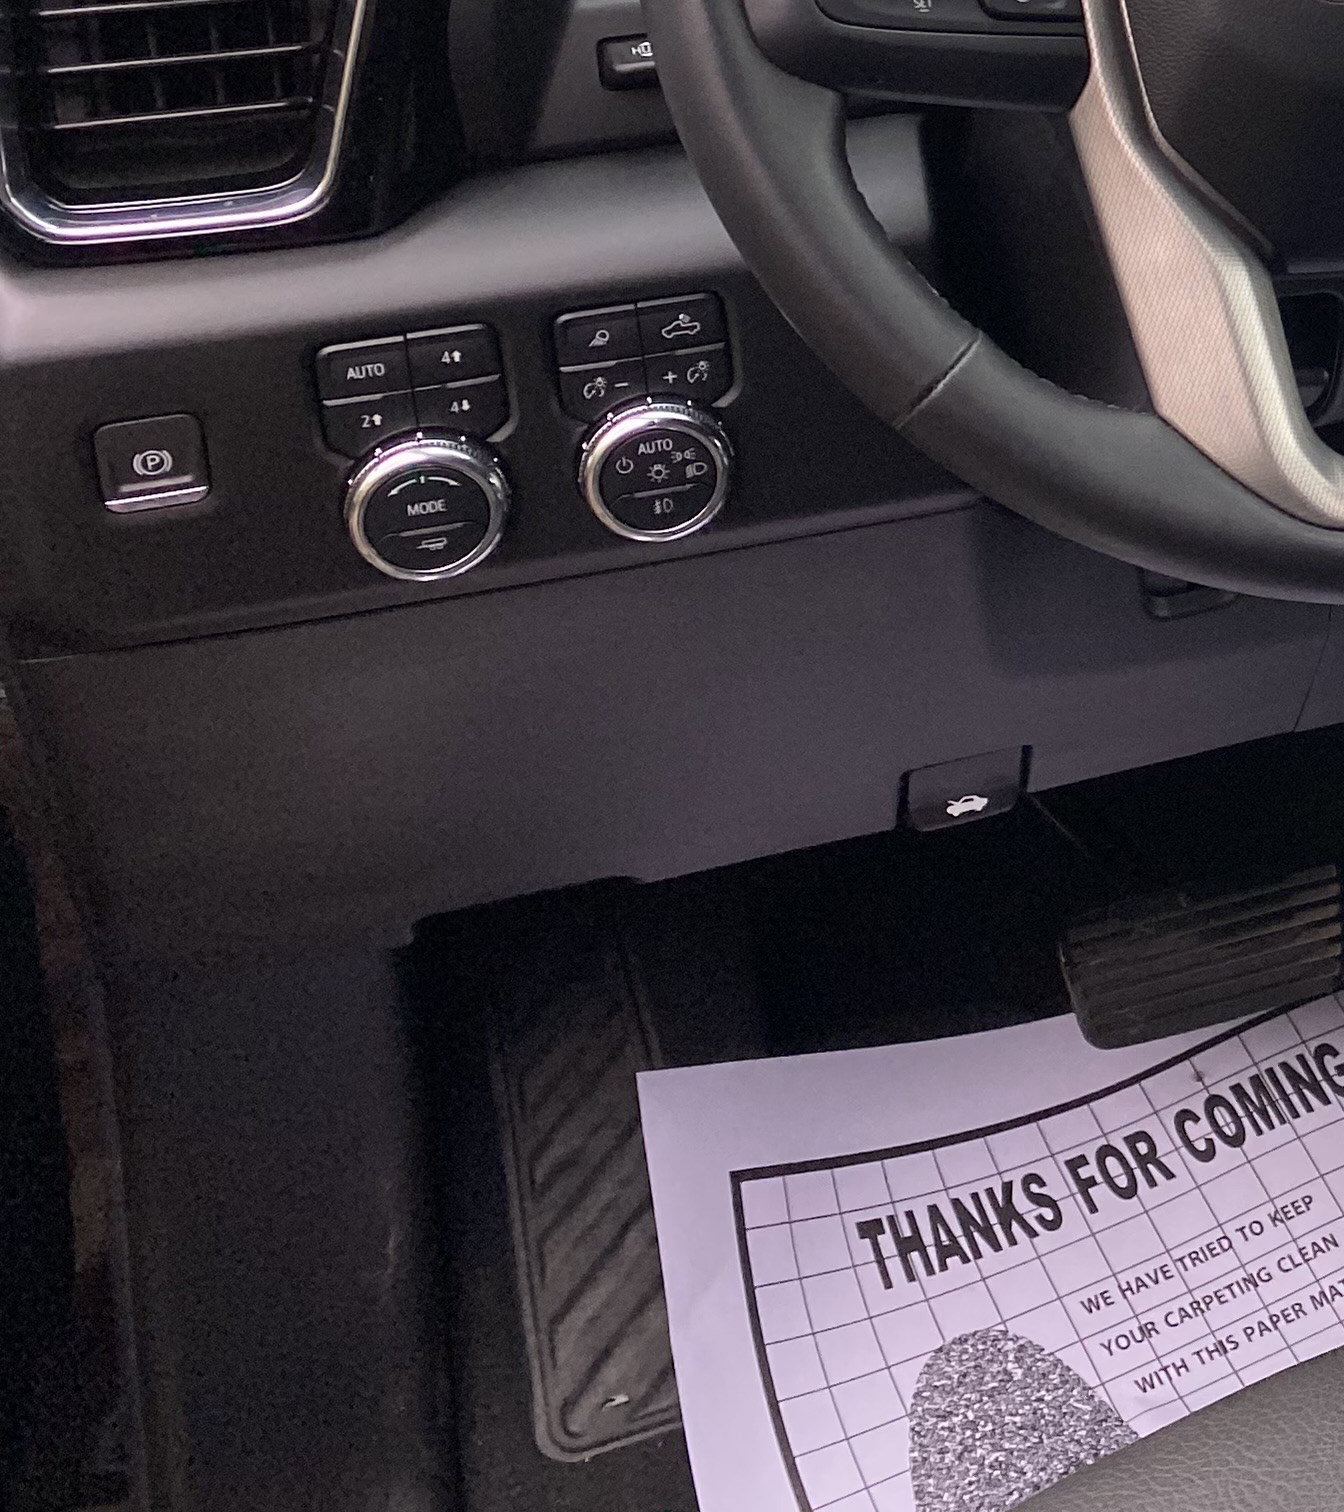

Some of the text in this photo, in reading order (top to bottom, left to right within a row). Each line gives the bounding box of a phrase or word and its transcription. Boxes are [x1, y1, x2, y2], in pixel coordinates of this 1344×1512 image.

[346, 362, 386, 381] AUTO
[637, 437, 674, 455] AUTO
[406, 498, 448, 517] MODE
[855, 1172, 1063, 1290] THANKS
[1064, 1129, 1177, 1215] FOR
[1079, 1194, 1314, 1315] WE HAVE TRIED TO KEEP
[1100, 1232, 1340, 1358] YOUR CARPETING CLEAN
[1133, 1357, 1190, 1394] WITH
[1191, 1334, 1240, 1367] THIS
[1242, 1302, 1308, 1344] PAPER
